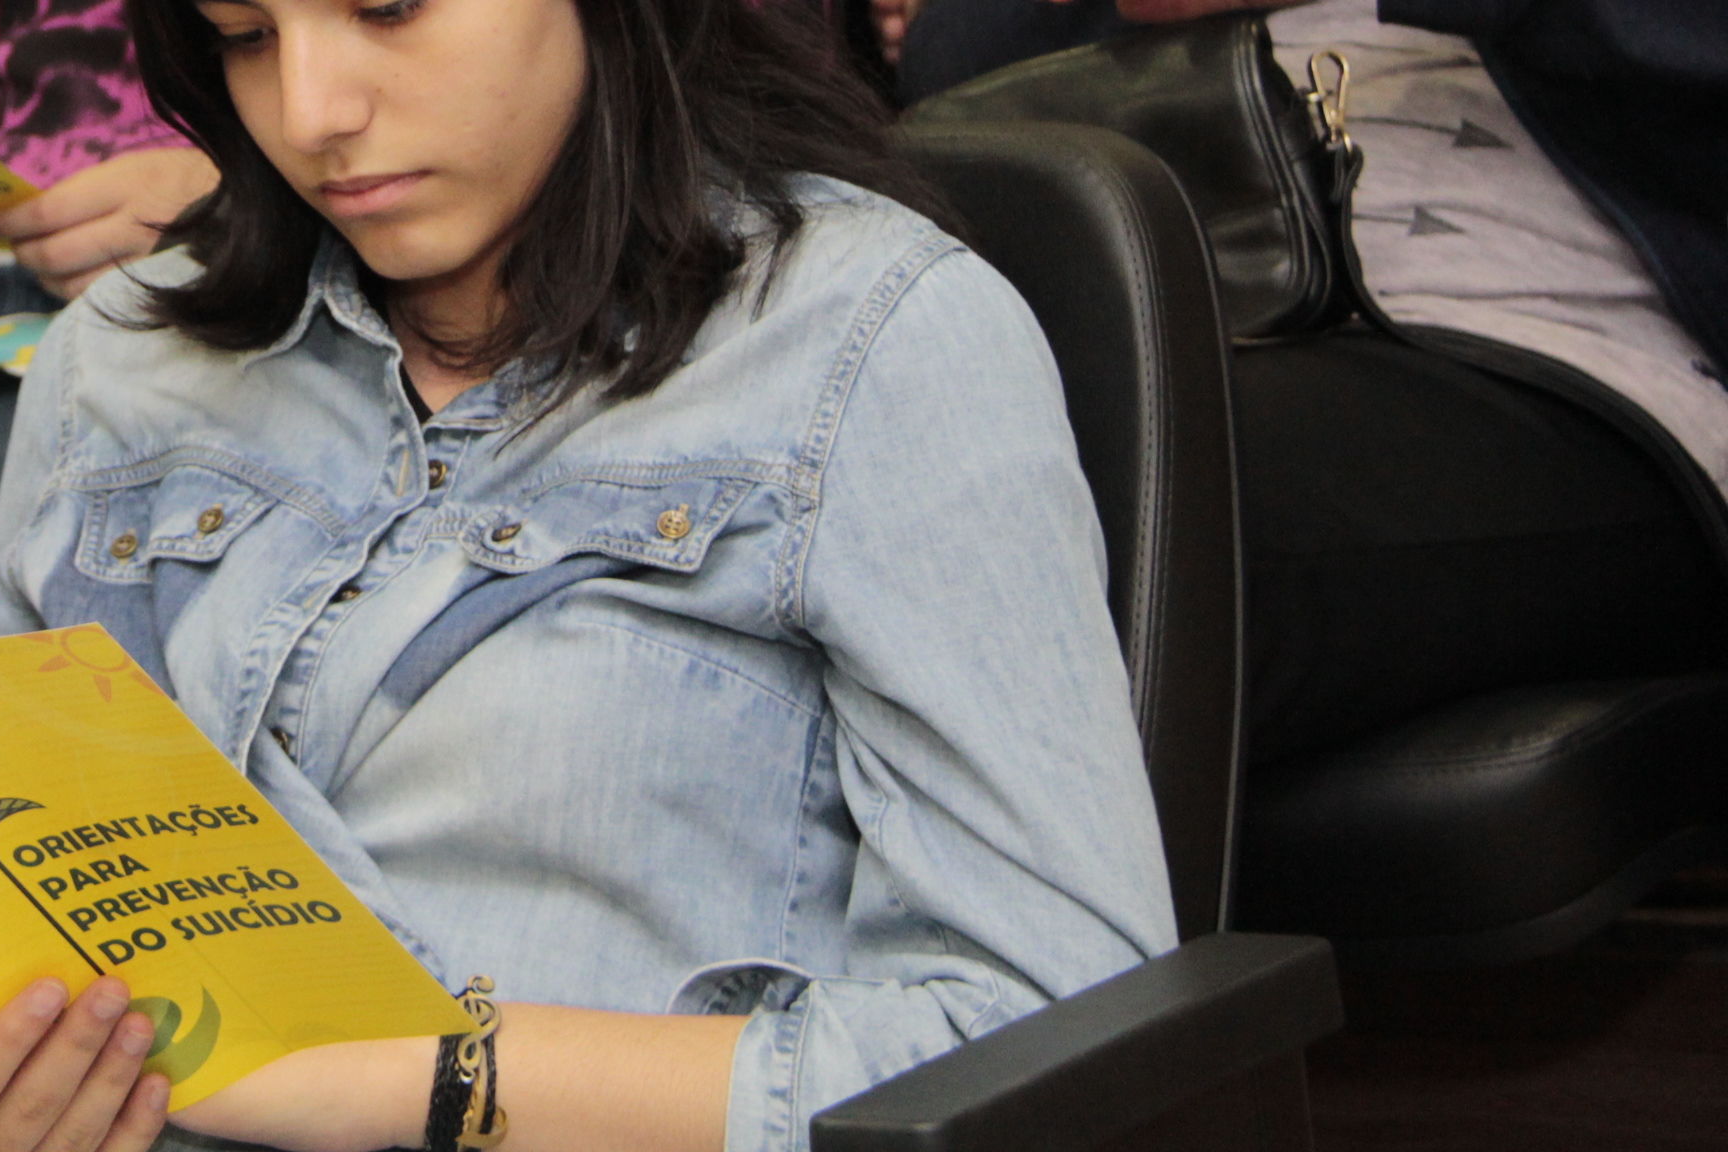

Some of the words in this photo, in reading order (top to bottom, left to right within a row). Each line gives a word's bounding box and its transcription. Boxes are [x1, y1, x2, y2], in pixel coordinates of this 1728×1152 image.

[13, 804, 260, 868] ORIENTAÇÕES
[38, 854, 151, 901] PARA
[67, 865, 300, 932] PREVENÇÃO
[97, 927, 167, 966] DO
[171, 899, 342, 940] SUICÍDIO
